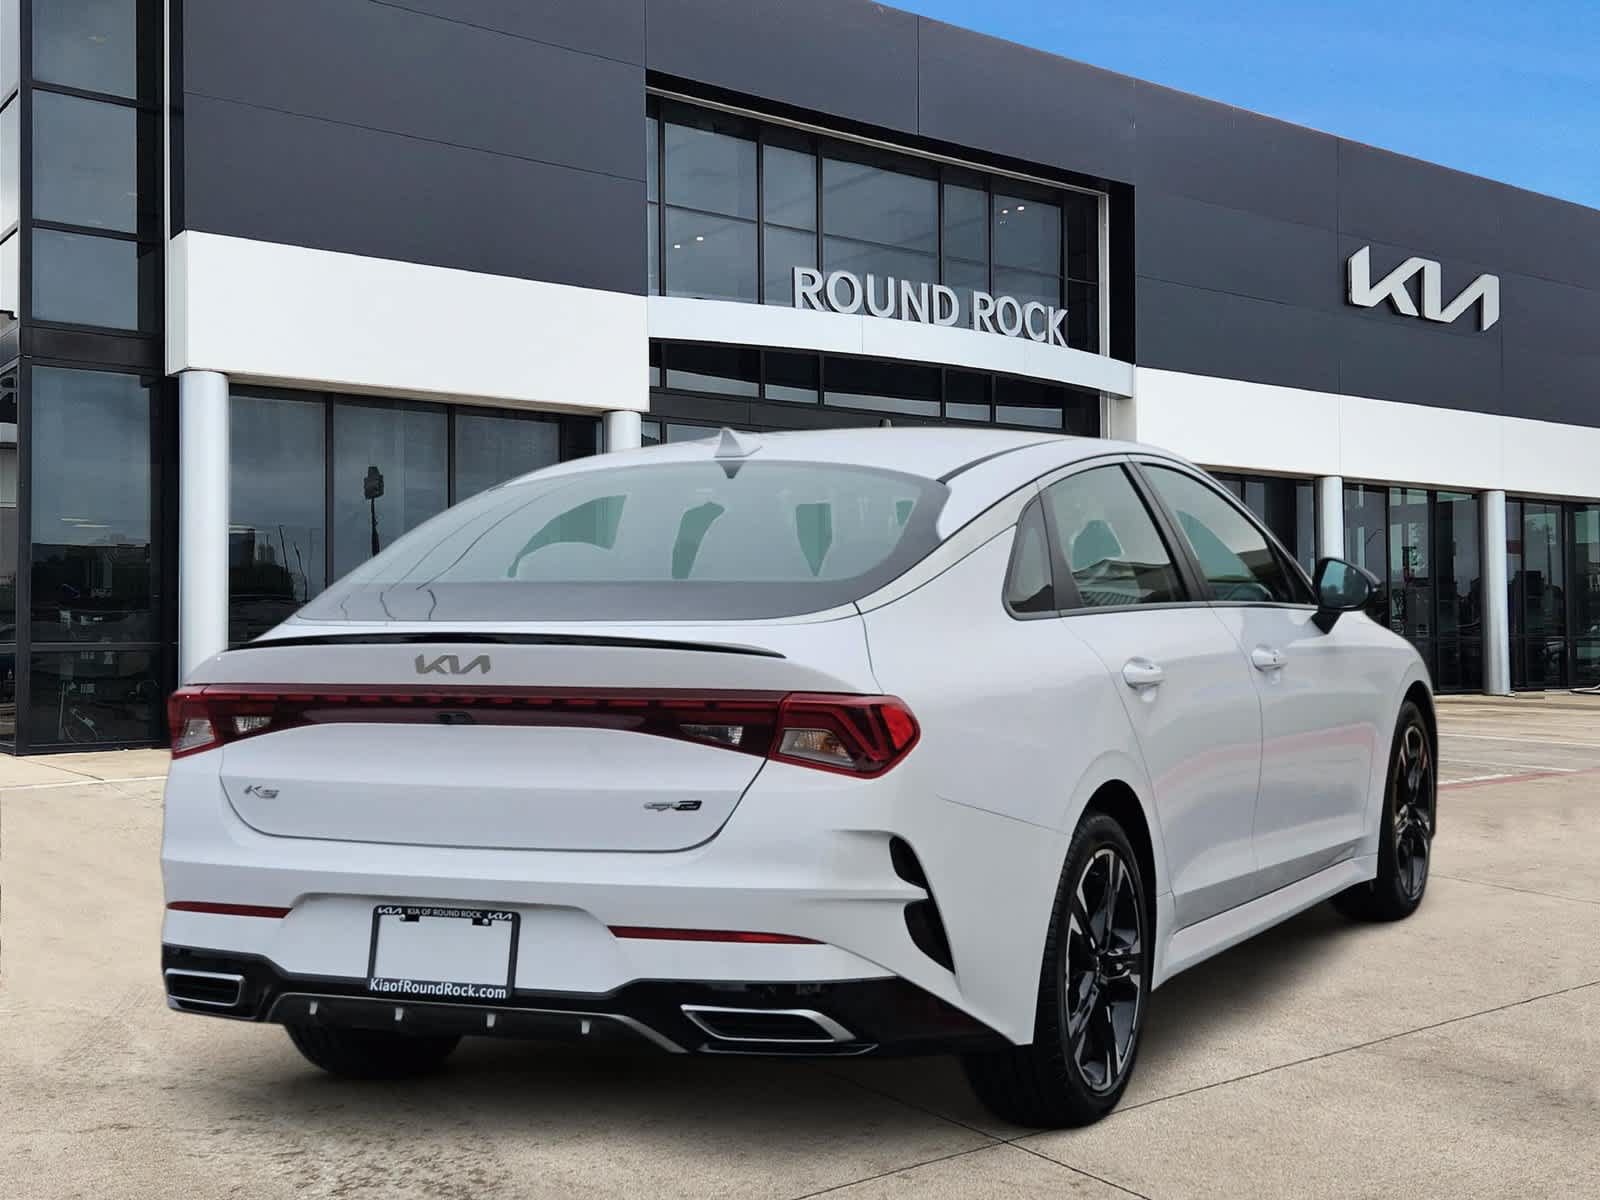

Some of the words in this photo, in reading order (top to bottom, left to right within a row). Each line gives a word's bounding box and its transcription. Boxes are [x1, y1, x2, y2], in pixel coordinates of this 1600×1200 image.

[1347, 245, 1500, 331] KIA
[792, 266, 959, 327] ROUND
[970, 290, 1069, 348] ROCK
[414, 654, 491, 675] KIA
[377, 906, 402, 915] KIA
[407, 907, 420, 916] KIA
[421, 908, 431, 916] OF
[433, 909, 460, 918] ROUND
[461, 910, 482, 919] ROCK
[487, 911, 513, 920] KIA
[369, 978, 507, 999] KiaofRoundRock.com
